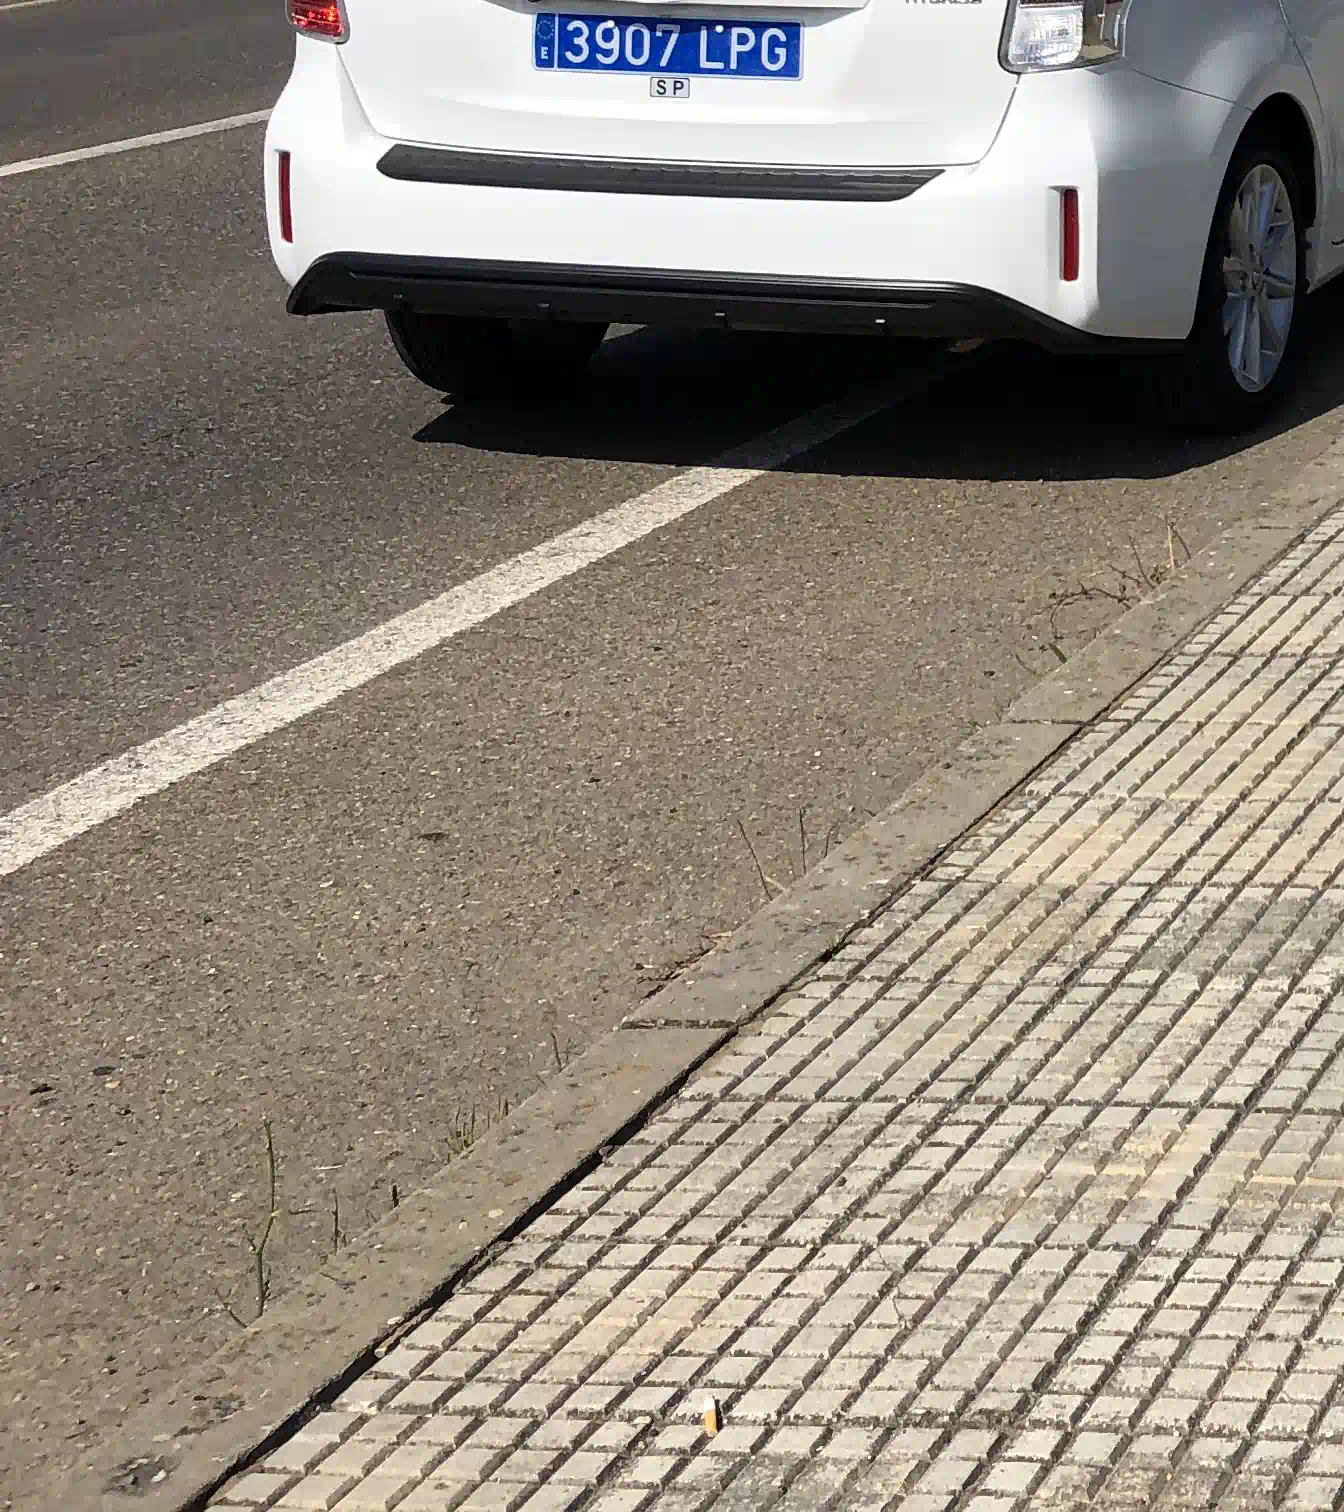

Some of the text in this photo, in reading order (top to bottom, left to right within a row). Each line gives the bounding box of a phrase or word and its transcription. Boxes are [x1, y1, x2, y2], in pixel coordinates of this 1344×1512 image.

[540, 46, 549, 60] E
[564, 20, 787, 71] 3907 LPG
